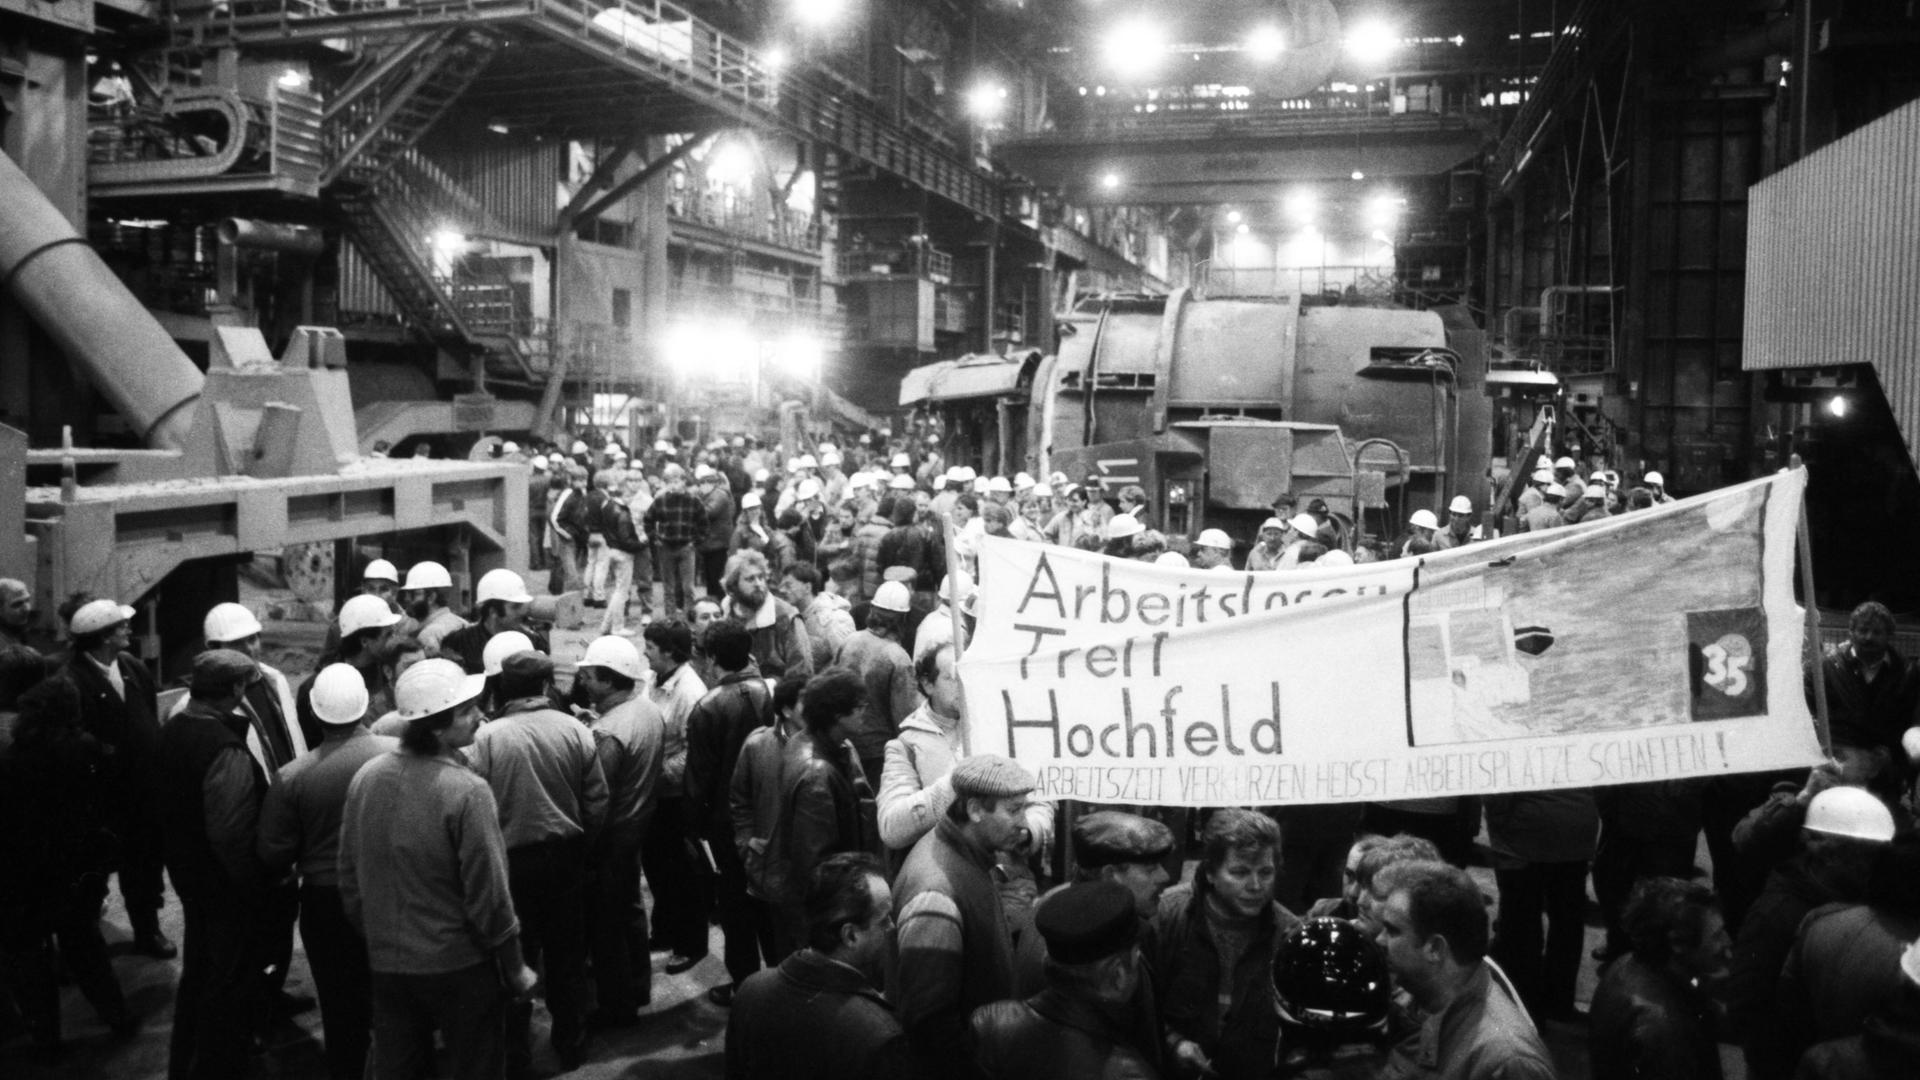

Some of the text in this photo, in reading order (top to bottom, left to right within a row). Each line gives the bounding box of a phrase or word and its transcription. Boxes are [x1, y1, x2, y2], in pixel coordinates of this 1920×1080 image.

[1702, 643, 1748, 696] 35
[1002, 681, 1283, 759] Hochfeld
[1034, 766, 1165, 800] ARBEITSZEIT
[1316, 758, 1392, 798] HEISST
